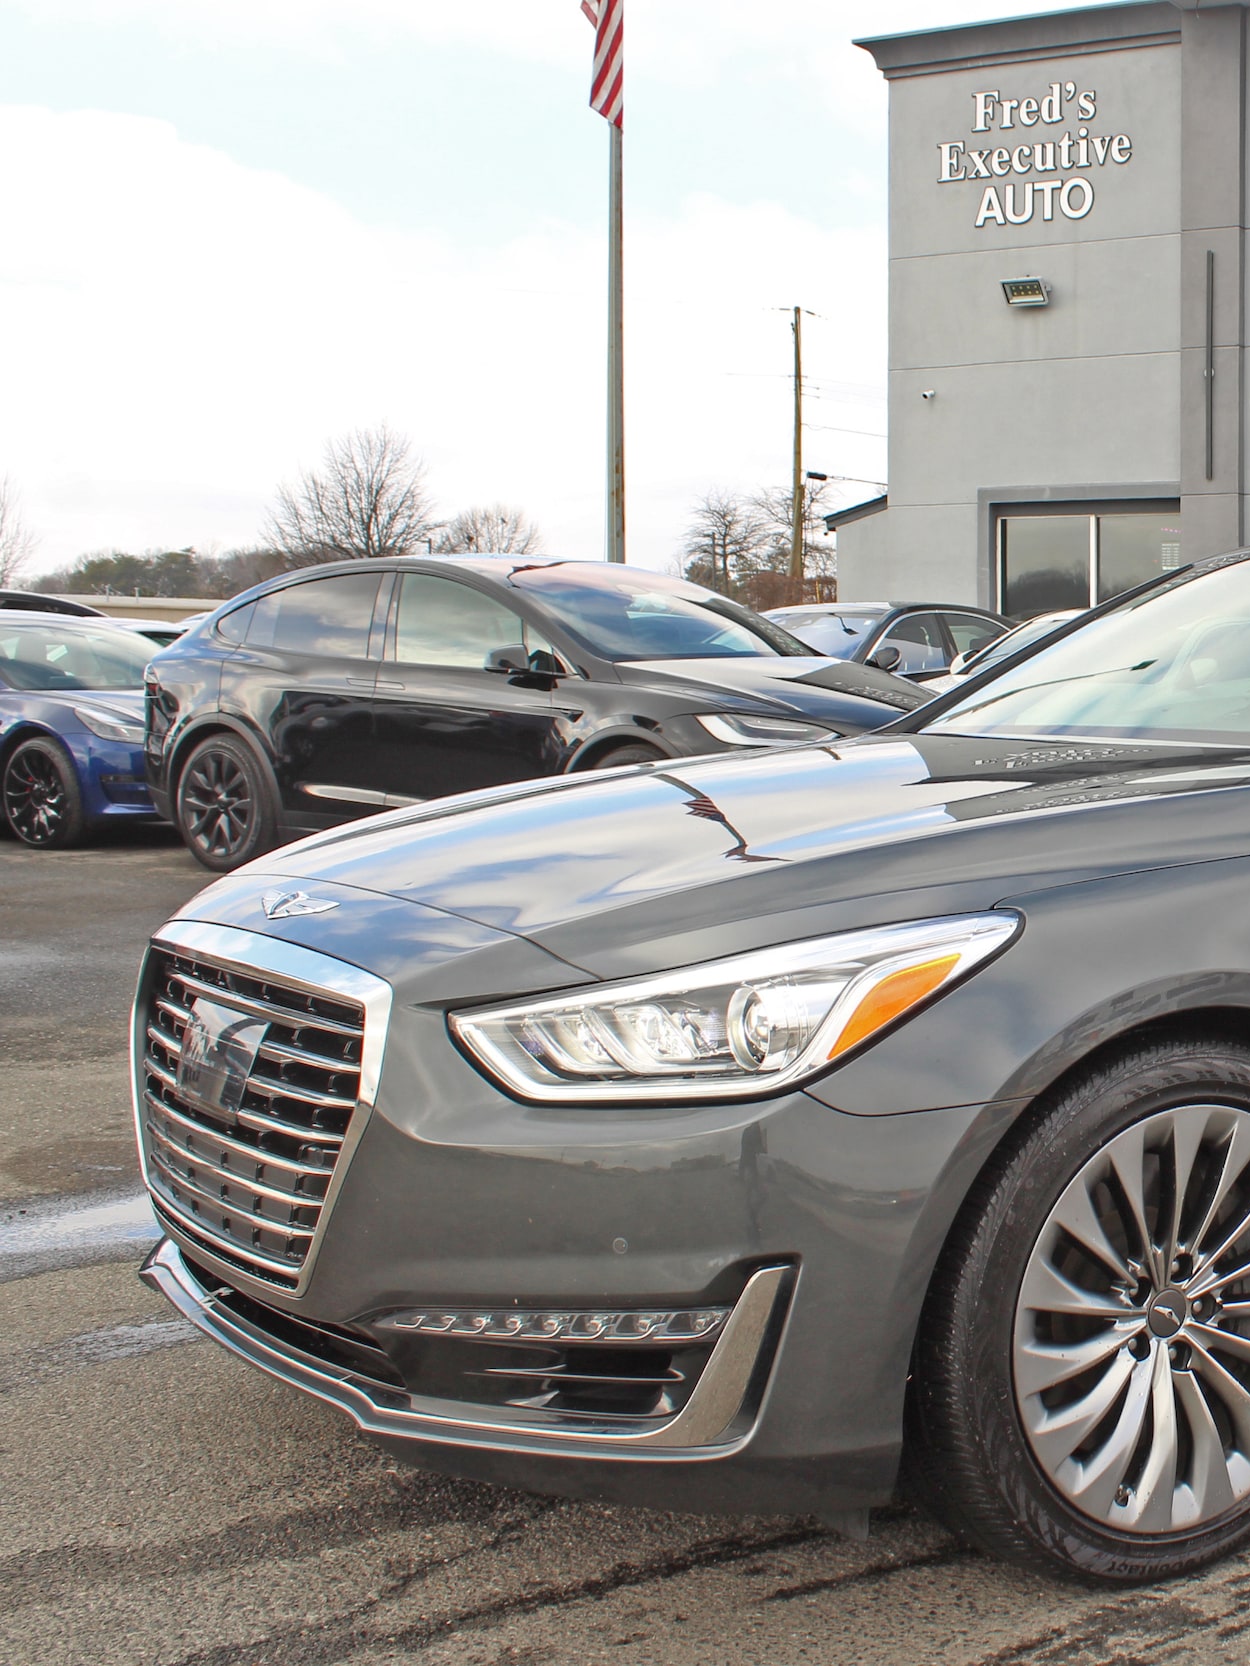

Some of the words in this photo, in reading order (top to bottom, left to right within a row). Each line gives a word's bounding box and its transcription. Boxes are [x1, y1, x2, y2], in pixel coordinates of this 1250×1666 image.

[971, 81, 1096, 132] Fred's
[937, 127, 1132, 182] Executive
[975, 176, 1094, 227] AUTO
